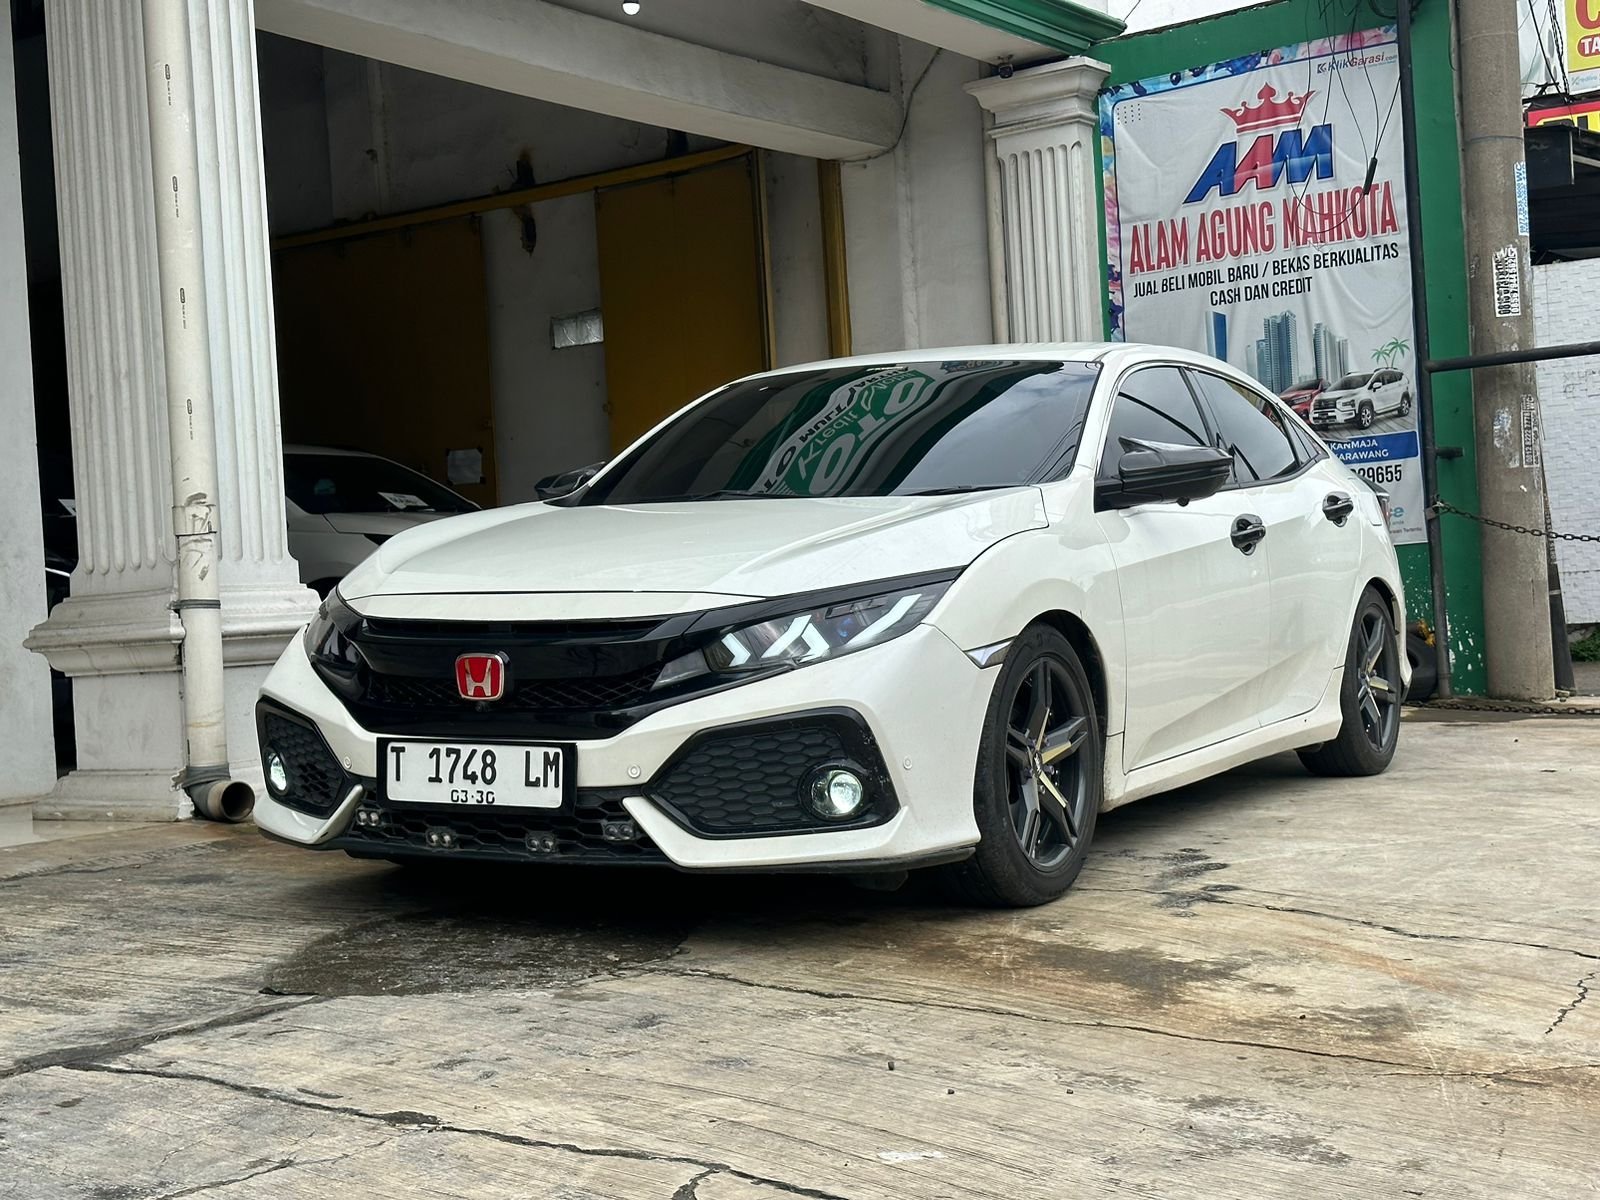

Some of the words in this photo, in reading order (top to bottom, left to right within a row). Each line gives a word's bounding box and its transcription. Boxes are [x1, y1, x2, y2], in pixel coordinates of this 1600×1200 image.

[1183, 123, 1334, 204] AAM
[1129, 217, 1189, 275] ALAM
[1196, 200, 1275, 264] AGUNG
[1283, 180, 1399, 249] MAHKOTA
[1133, 279, 1158, 298] JUAL
[1161, 274, 1185, 293] BELI
[1188, 268, 1225, 291] MOBIL
[1227, 262, 1259, 283] BARU
[1262, 261, 1269, 277] /
[1272, 253, 1310, 275] BEKAS
[1313, 242, 1399, 269] BERKUALITAS
[1210, 286, 1241, 306] CASH
[1244, 283, 1269, 301] DAN
[1272, 276, 1312, 297] CREDIT
[390, 746, 406, 782] T
[428, 747, 497, 786] 1748
[524, 750, 560, 789] LM
